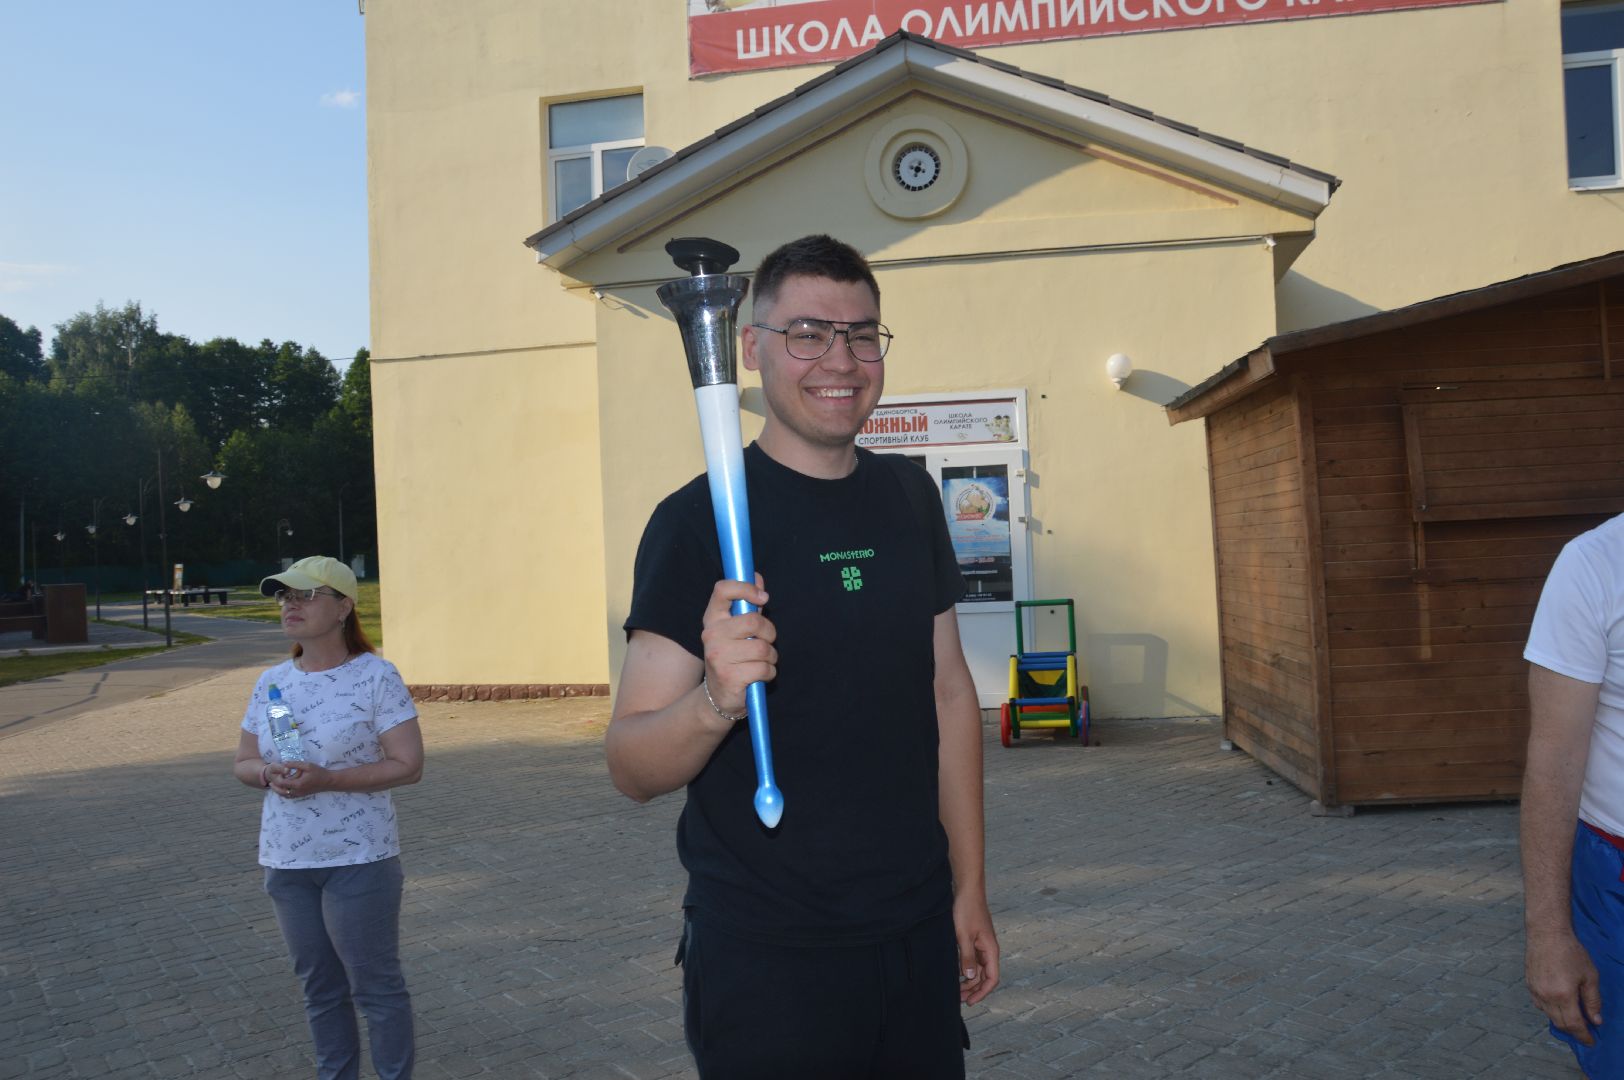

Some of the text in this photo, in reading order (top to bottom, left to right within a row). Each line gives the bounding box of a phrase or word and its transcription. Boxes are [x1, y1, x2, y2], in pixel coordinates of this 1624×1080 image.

[736, 15, 885, 60] ШКОЛА
[933, 417, 988, 425] ОЛИМПИЙСКОГО
[858, 434, 929, 445] СПОРТИВНЫЙ КЛУБ
[819, 548, 874, 562] MONASTERIO
